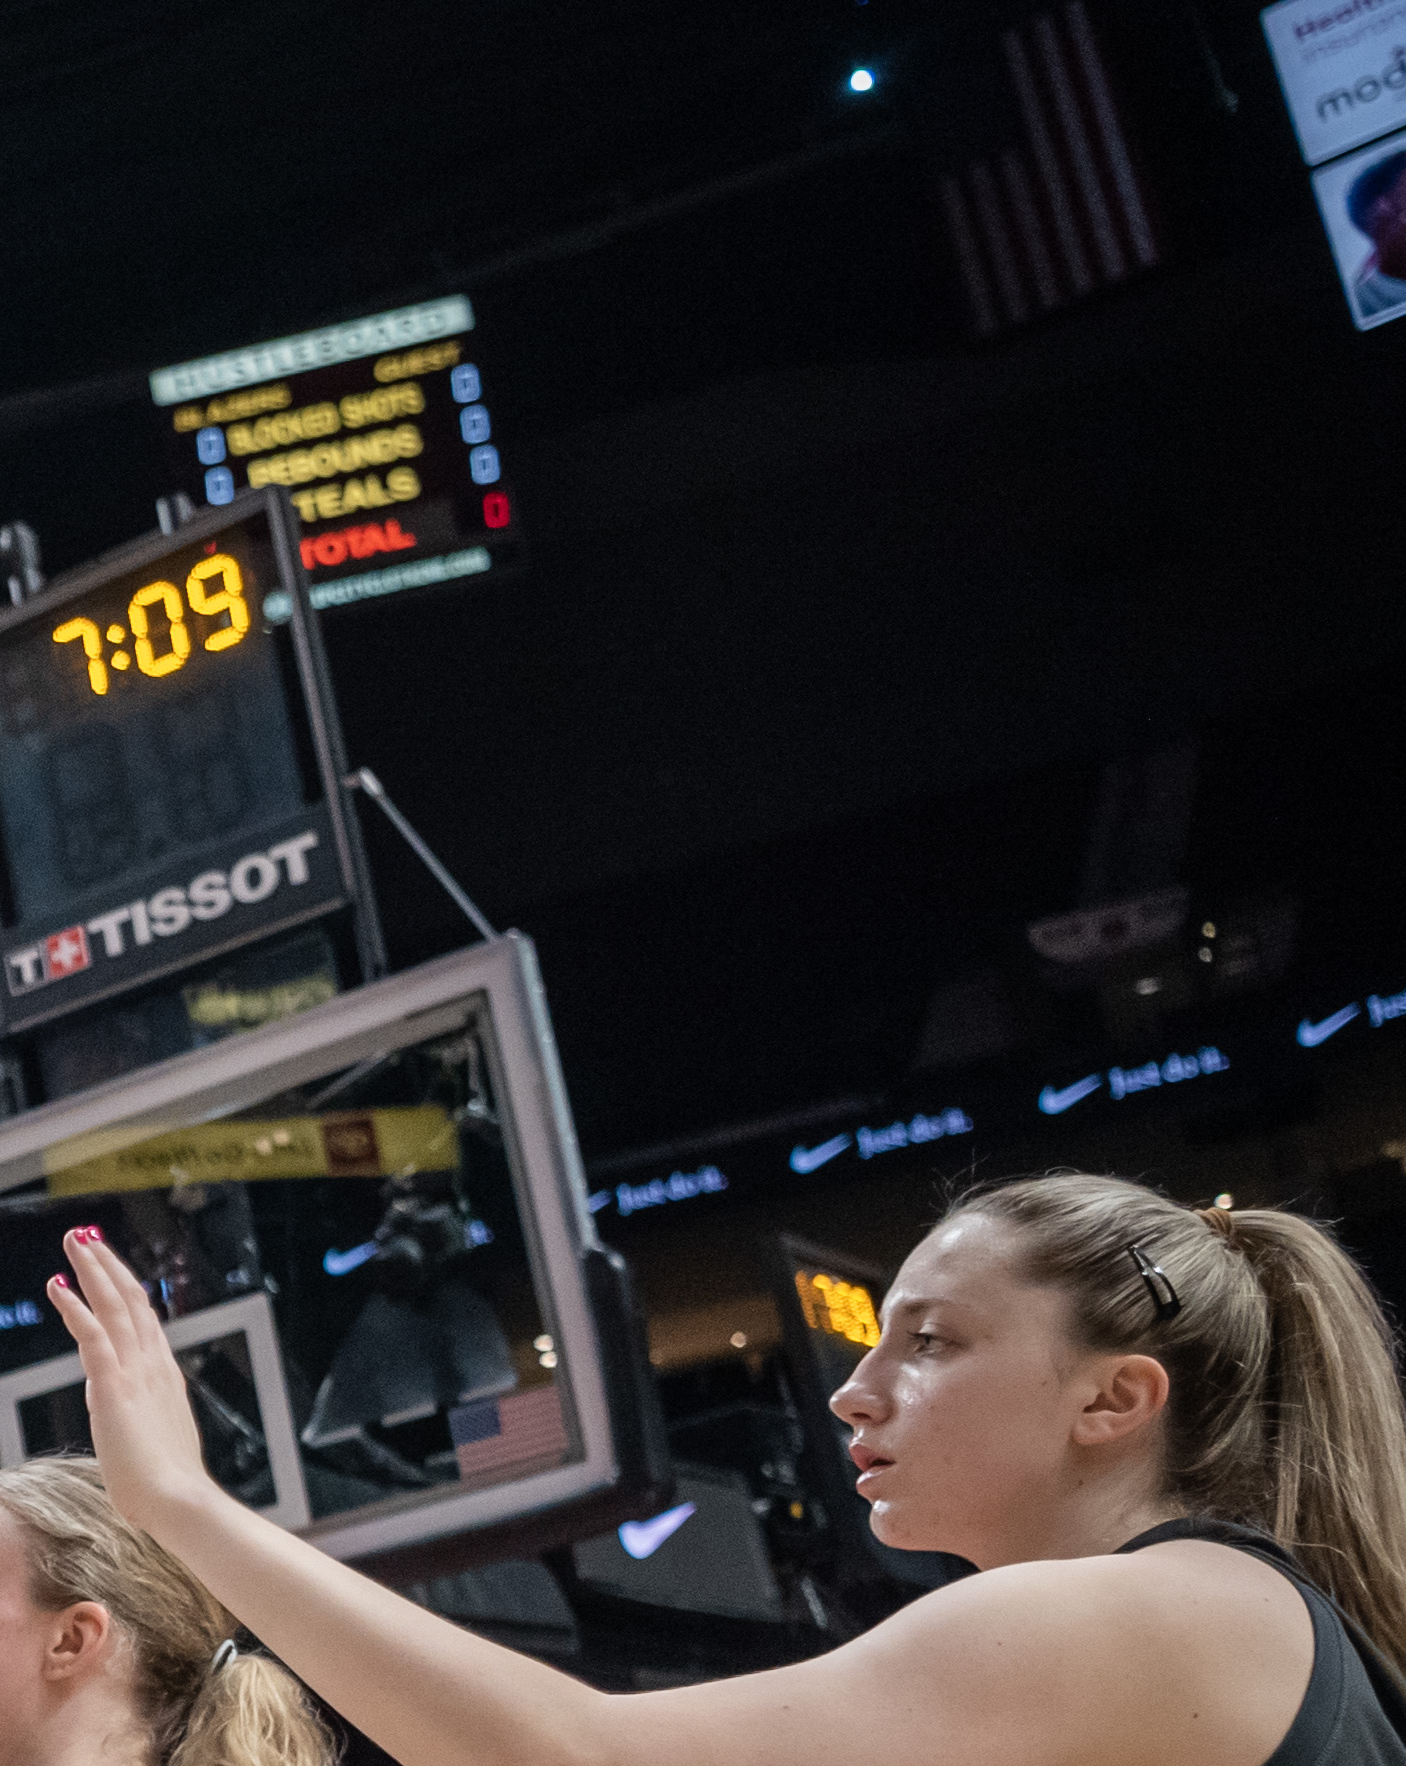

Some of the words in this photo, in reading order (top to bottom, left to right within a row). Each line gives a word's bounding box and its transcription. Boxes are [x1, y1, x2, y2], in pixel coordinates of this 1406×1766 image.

[226, 402, 339, 456] BLOCKED
[340, 381, 425, 428] SHOTS
[247, 423, 423, 489] REBOUNDS
[53, 554, 250, 694] 7:09
[88, 830, 318, 957] TISSOT
